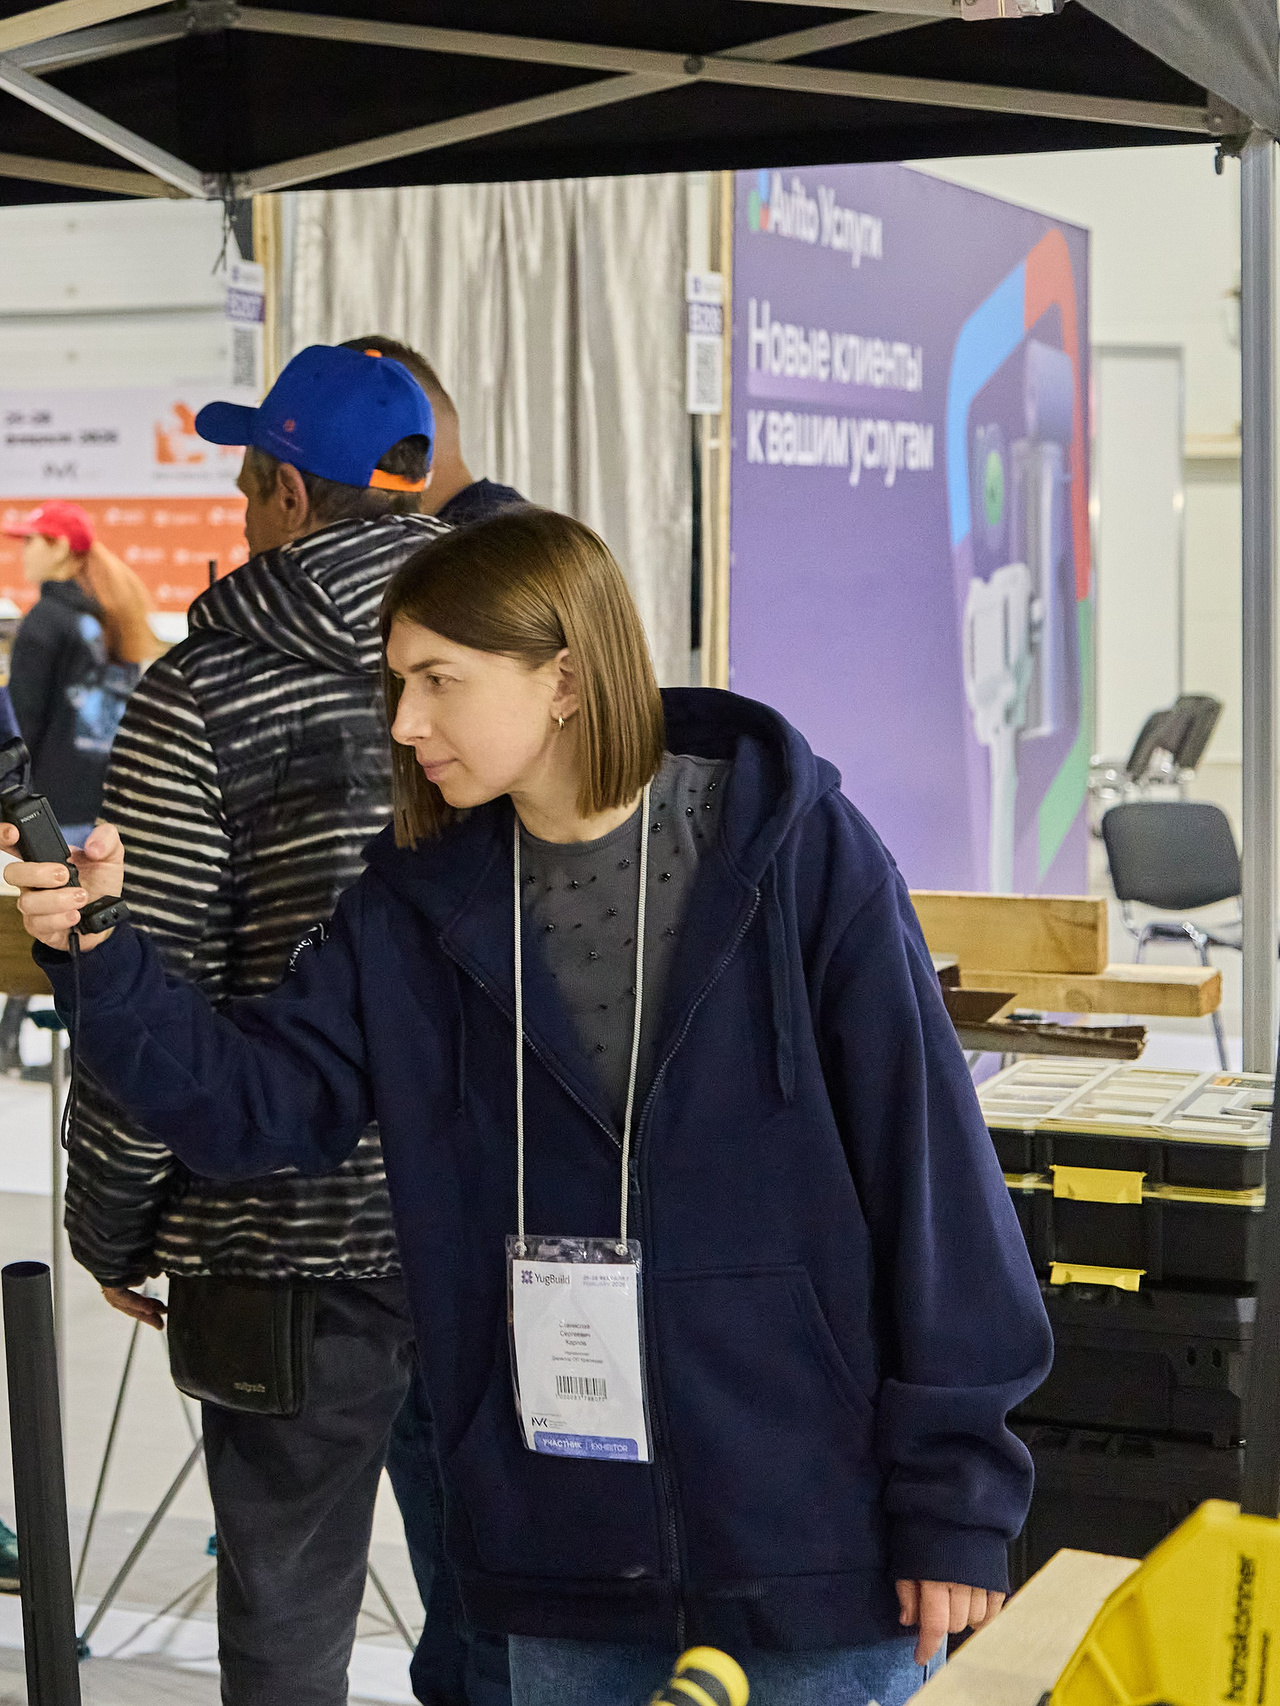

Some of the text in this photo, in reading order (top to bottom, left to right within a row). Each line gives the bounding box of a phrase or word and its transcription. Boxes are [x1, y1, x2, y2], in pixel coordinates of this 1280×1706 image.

[769, 172, 883, 269] Avito Услуги
[748, 298, 831, 380] Новые
[832, 332, 923, 392] клиенты
[747, 409, 934, 488] к вашим услугам
[534, 1272, 570, 1286] YugBuild
